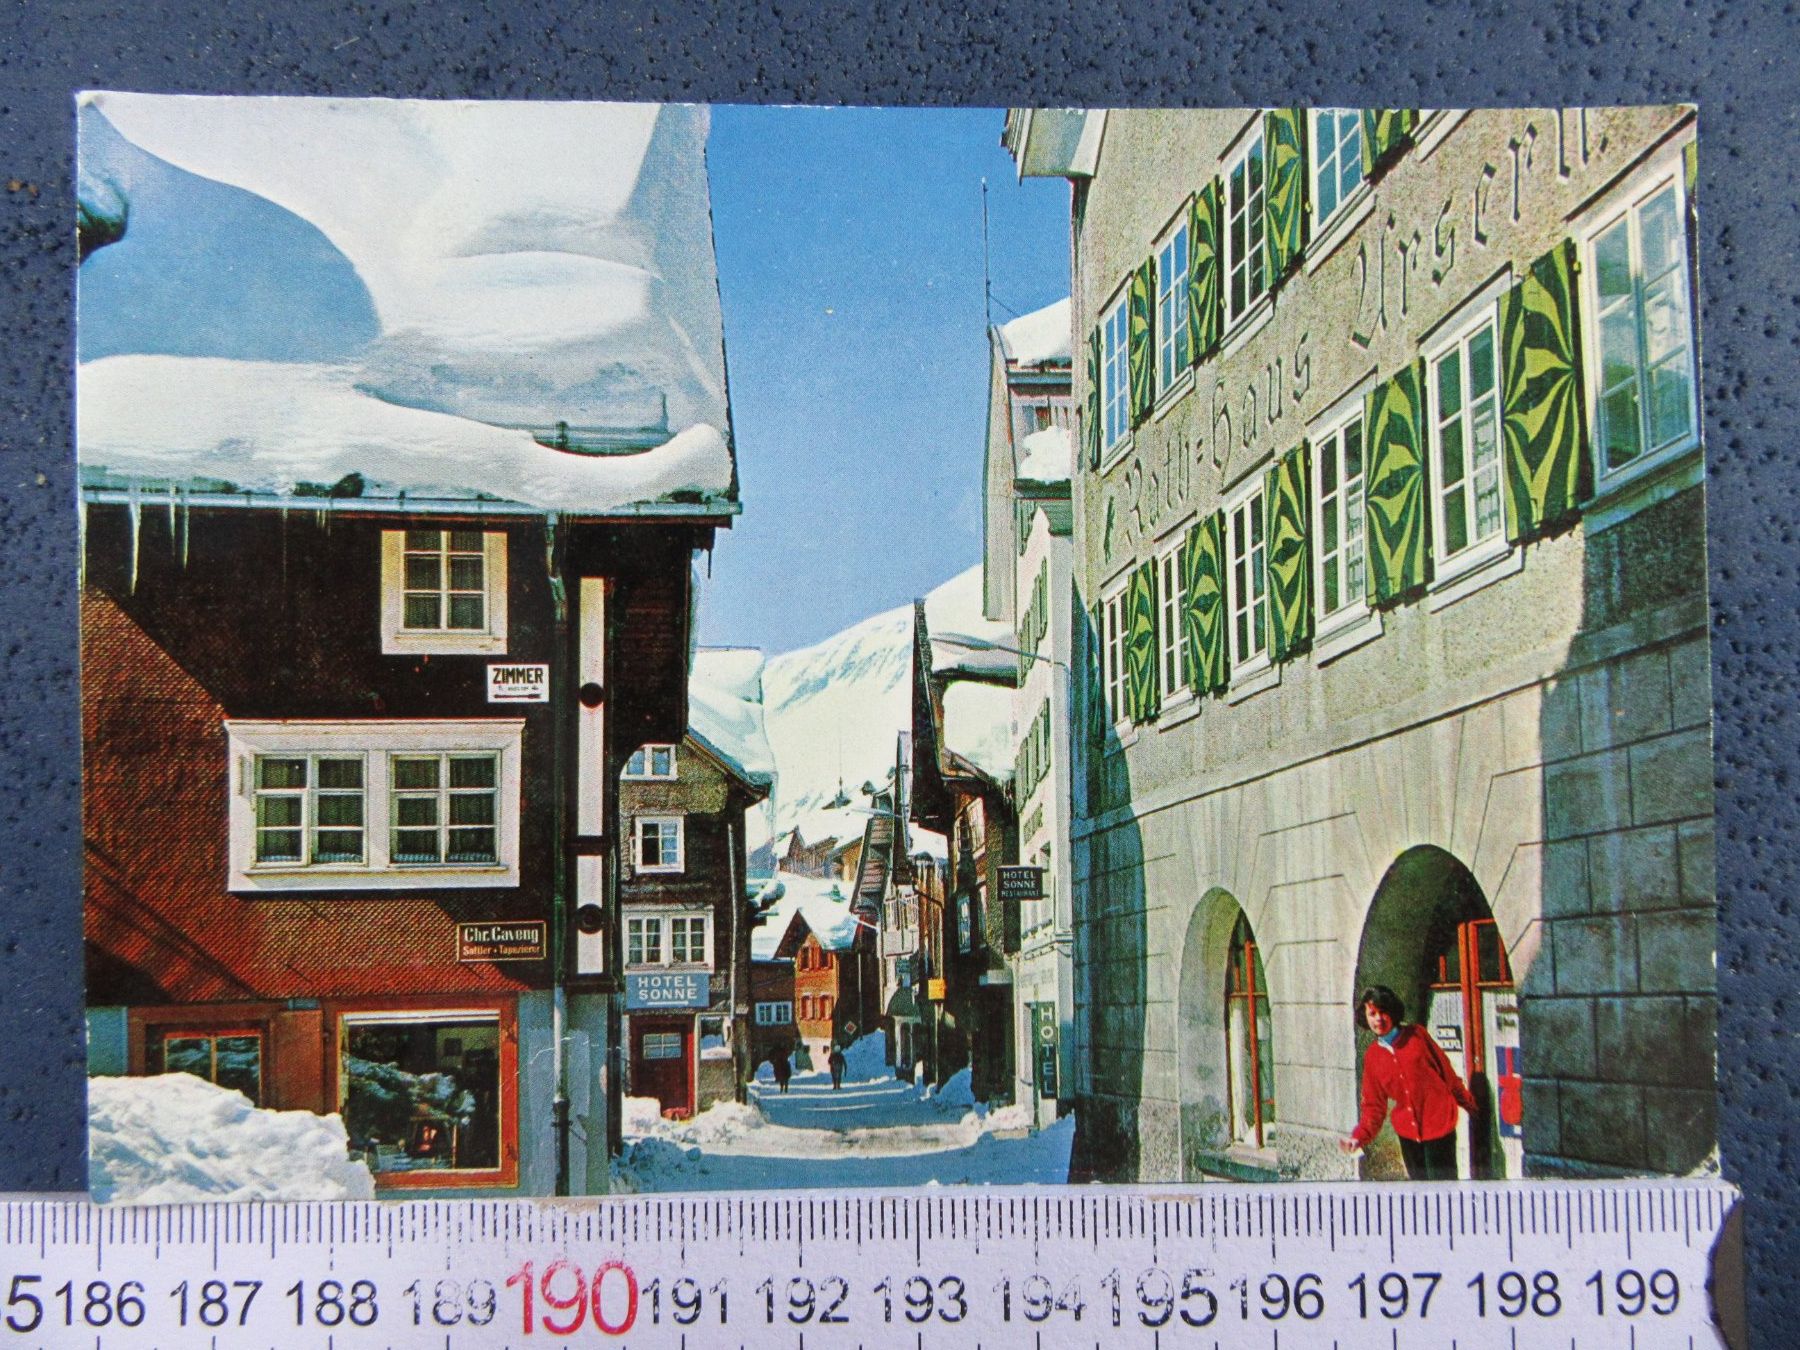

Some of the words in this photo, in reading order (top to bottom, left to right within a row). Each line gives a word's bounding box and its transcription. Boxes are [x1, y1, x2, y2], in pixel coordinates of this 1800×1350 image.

[493, 667, 543, 684] ZIMMER
[1003, 871, 1036, 879] HOTEL
[1003, 880, 1036, 888] SONNE
[638, 976, 697, 988] HOTEL
[639, 988, 698, 1000] SONNE
[1041, 1007, 1055, 1094] HOTEL
[55, 1280, 146, 1327] 186
[169, 1280, 263, 1327] 187
[285, 1279, 379, 1327] 188
[402, 1278, 497, 1326] 189
[505, 1260, 640, 1336] 190
[642, 1276, 729, 1325] 191
[754, 1274, 850, 1324] 192
[872, 1274, 968, 1323] 193
[992, 1272, 1088, 1322] 194
[1100, 1267, 1219, 1328] 195
[1229, 1272, 1325, 1320] 196
[1347, 1271, 1443, 1319] 197
[1466, 1270, 1563, 1318] 198
[1584, 1268, 1681, 1317] 199
